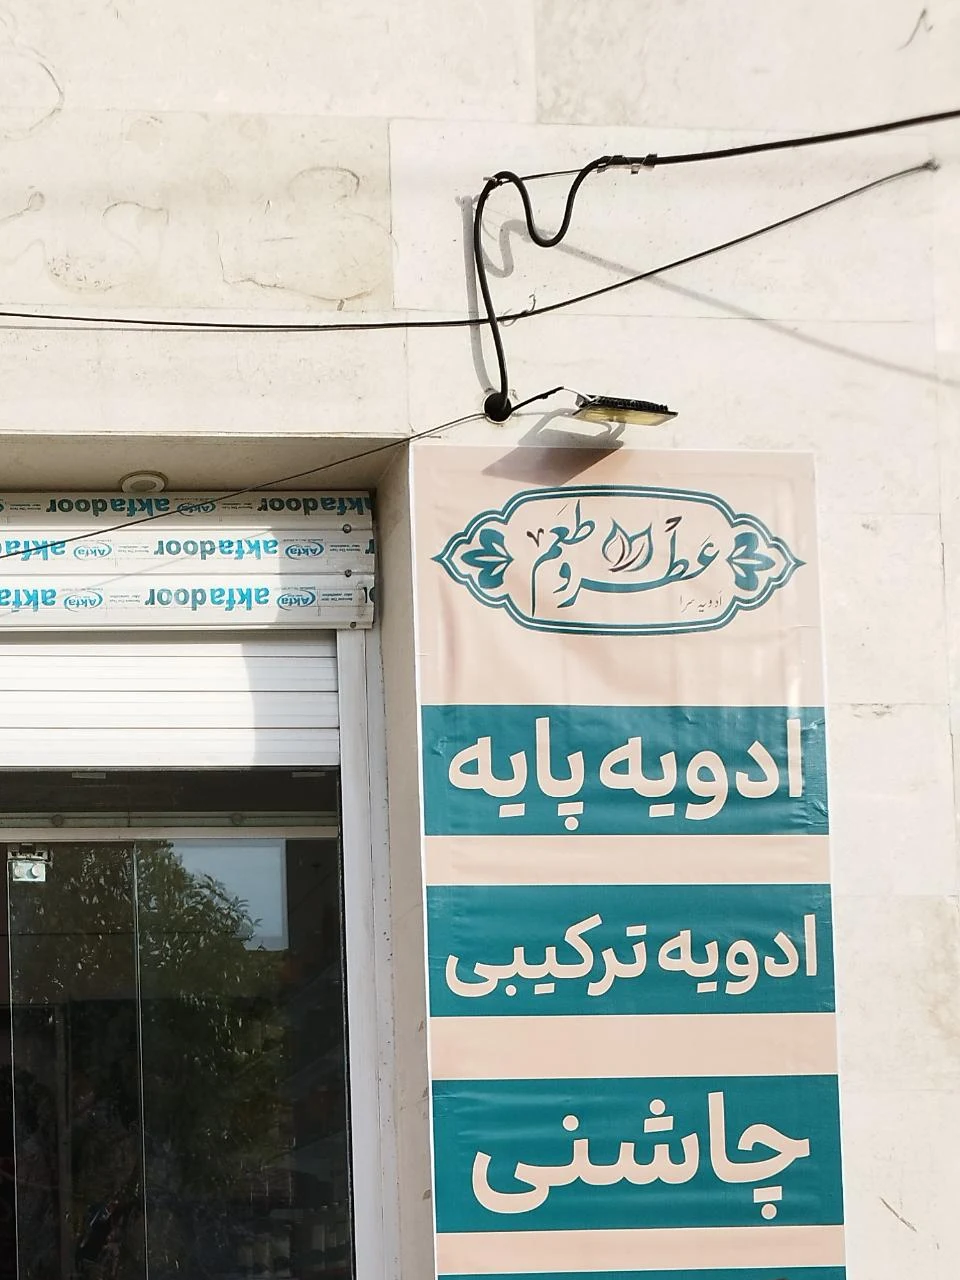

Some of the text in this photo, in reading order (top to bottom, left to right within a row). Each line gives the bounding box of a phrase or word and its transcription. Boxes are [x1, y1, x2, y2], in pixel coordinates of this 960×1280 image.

[46, 498, 170, 517] akfadoor
[78, 544, 109, 558] Akfa
[154, 539, 278, 560] akfadoor
[290, 543, 320, 557] Akfa
[69, 593, 99, 608] Akfa
[145, 588, 269, 611] akfadoor
[281, 592, 311, 607] Akfa
[447, 716, 803, 831] ادویه پایه
[444, 912, 818, 998] ادویه ترکیبی
[471, 1090, 811, 1221] چاشنی
